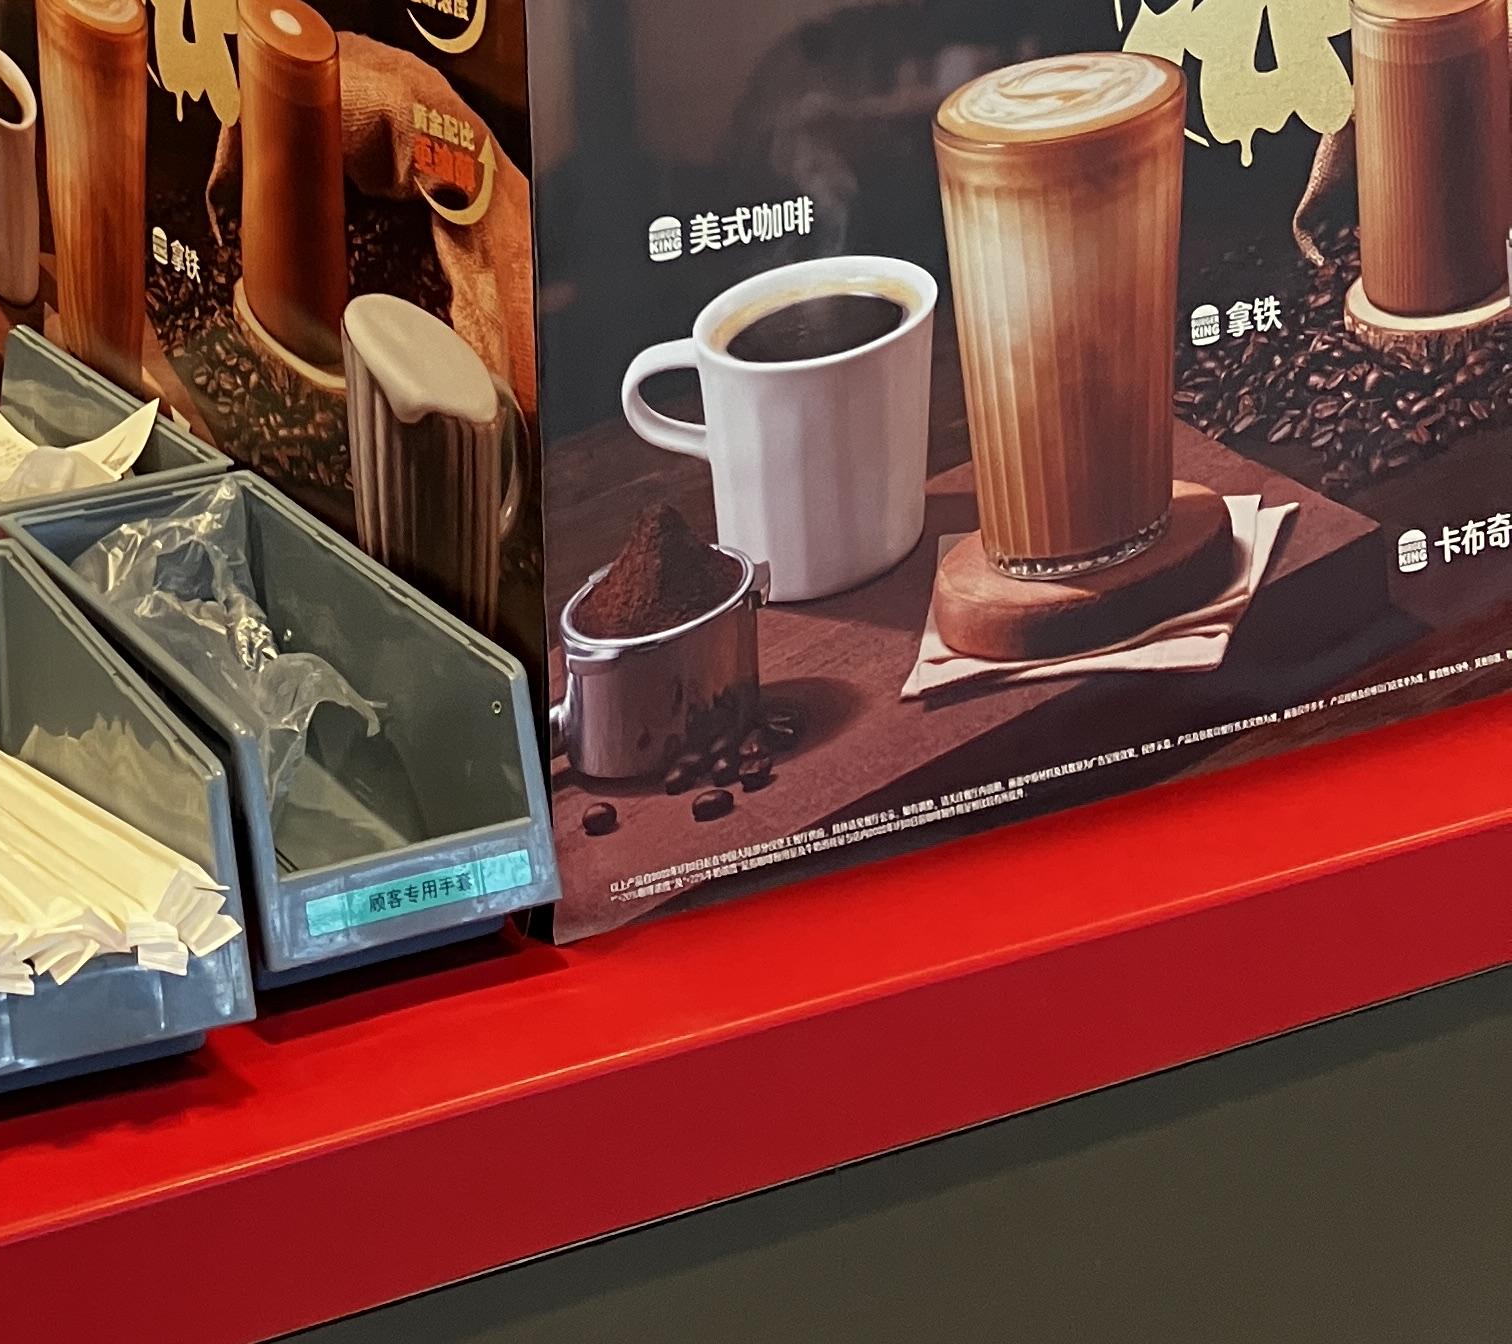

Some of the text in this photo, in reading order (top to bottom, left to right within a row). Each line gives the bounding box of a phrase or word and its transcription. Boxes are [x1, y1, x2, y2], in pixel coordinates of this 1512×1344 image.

[649, 195, 814, 255] KING 美式咖啡
[170, 239, 201, 284] 拿铁
[1191, 295, 1283, 339] KING 拿铁
[1399, 512, 1512, 567] KING 卡布奇
[368, 872, 473, 913] 顾客专用手套
